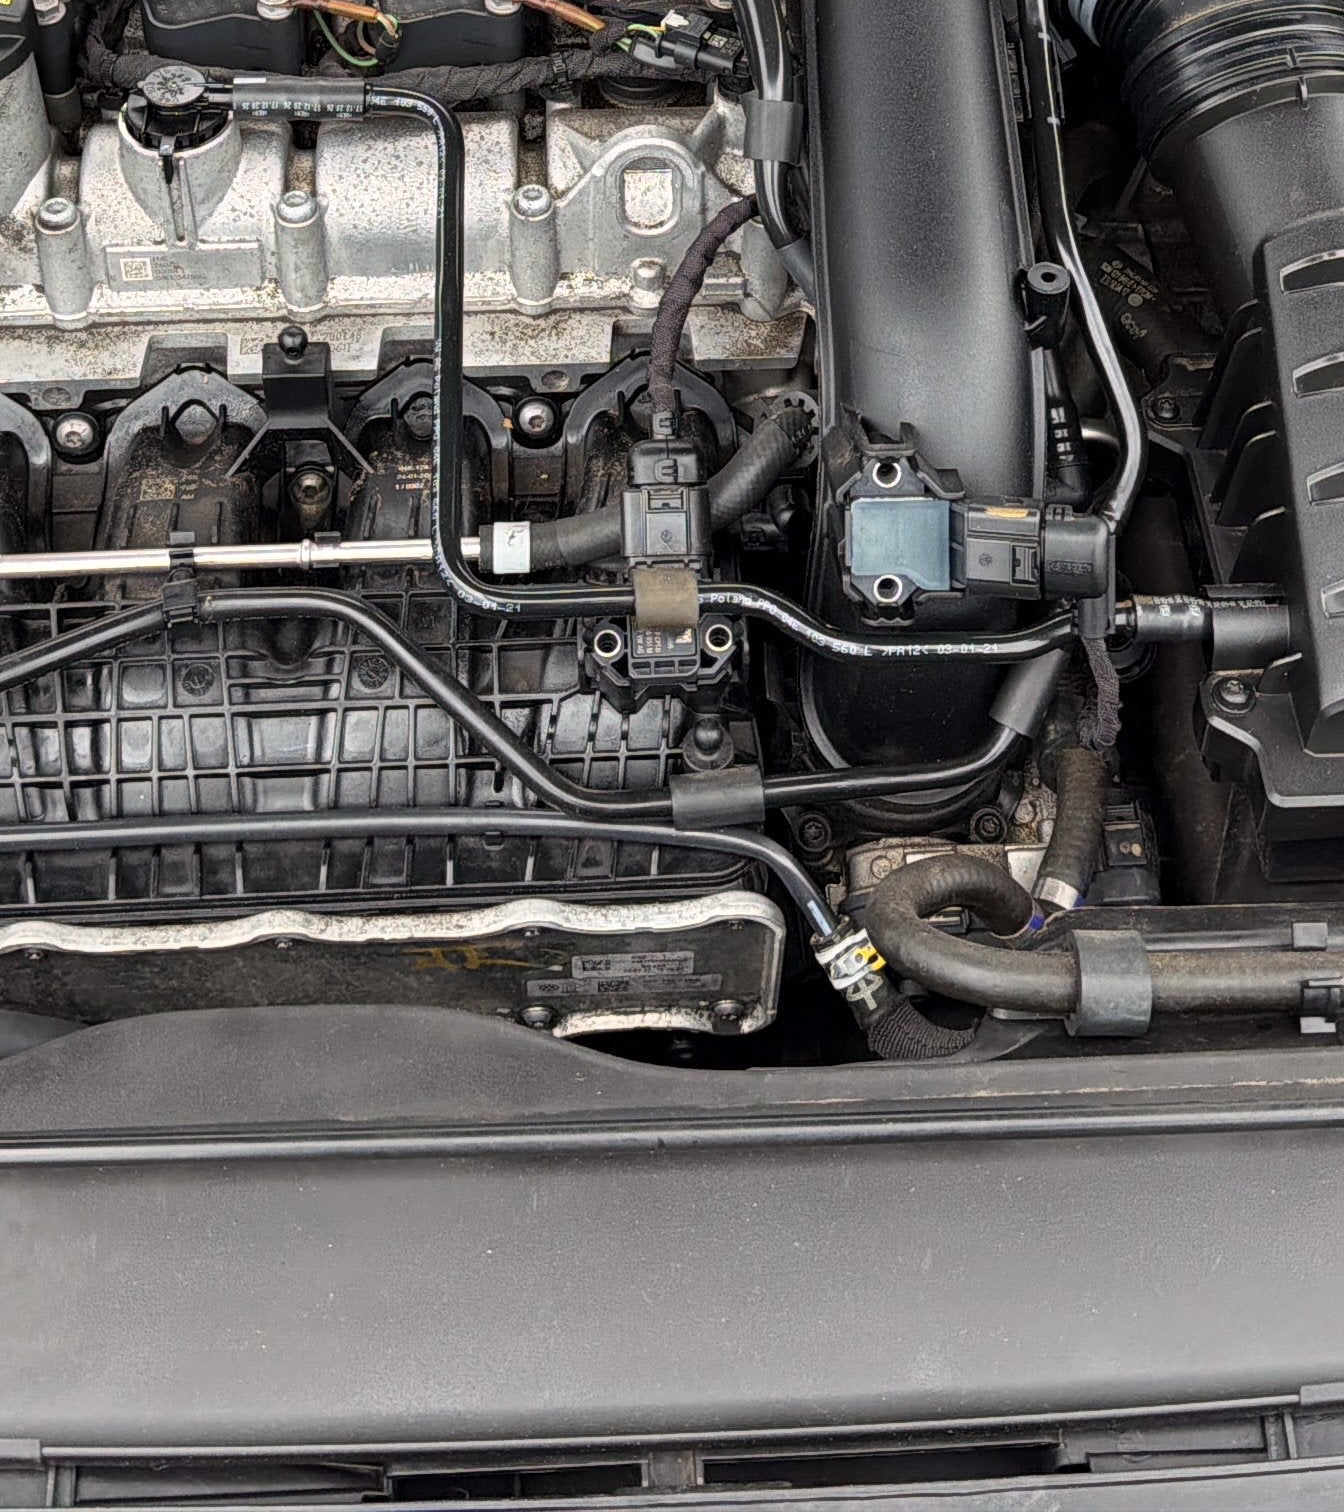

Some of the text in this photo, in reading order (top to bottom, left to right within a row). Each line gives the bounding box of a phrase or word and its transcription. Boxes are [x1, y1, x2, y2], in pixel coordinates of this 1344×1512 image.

[710, 592, 753, 606] Poland
[832, 641, 856, 656] 560
[864, 645, 873, 657] L
[882, 645, 929, 657] >PA12<
[937, 642, 999, 655] 03-01-21
